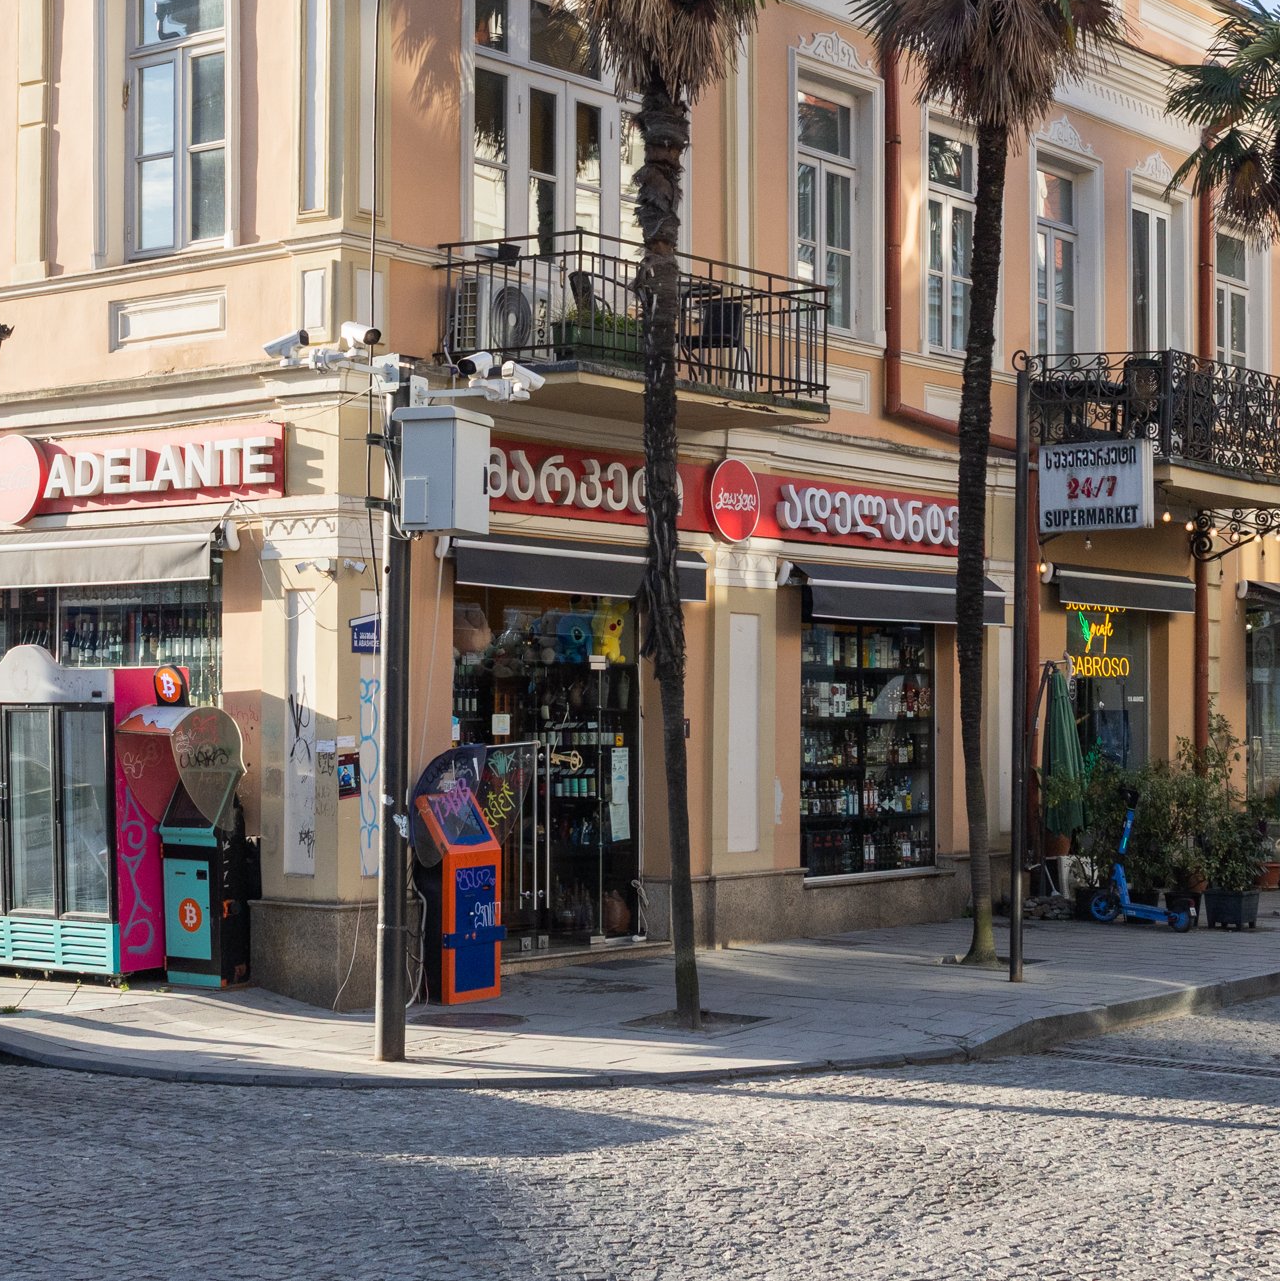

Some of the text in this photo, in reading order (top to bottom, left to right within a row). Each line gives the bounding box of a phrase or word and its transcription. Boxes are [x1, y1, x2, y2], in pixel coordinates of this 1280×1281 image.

[43, 436, 276, 498] ADELANTE
[1067, 475, 1117, 500] 24/7
[1045, 505, 1138, 528] SUPERMARKET
